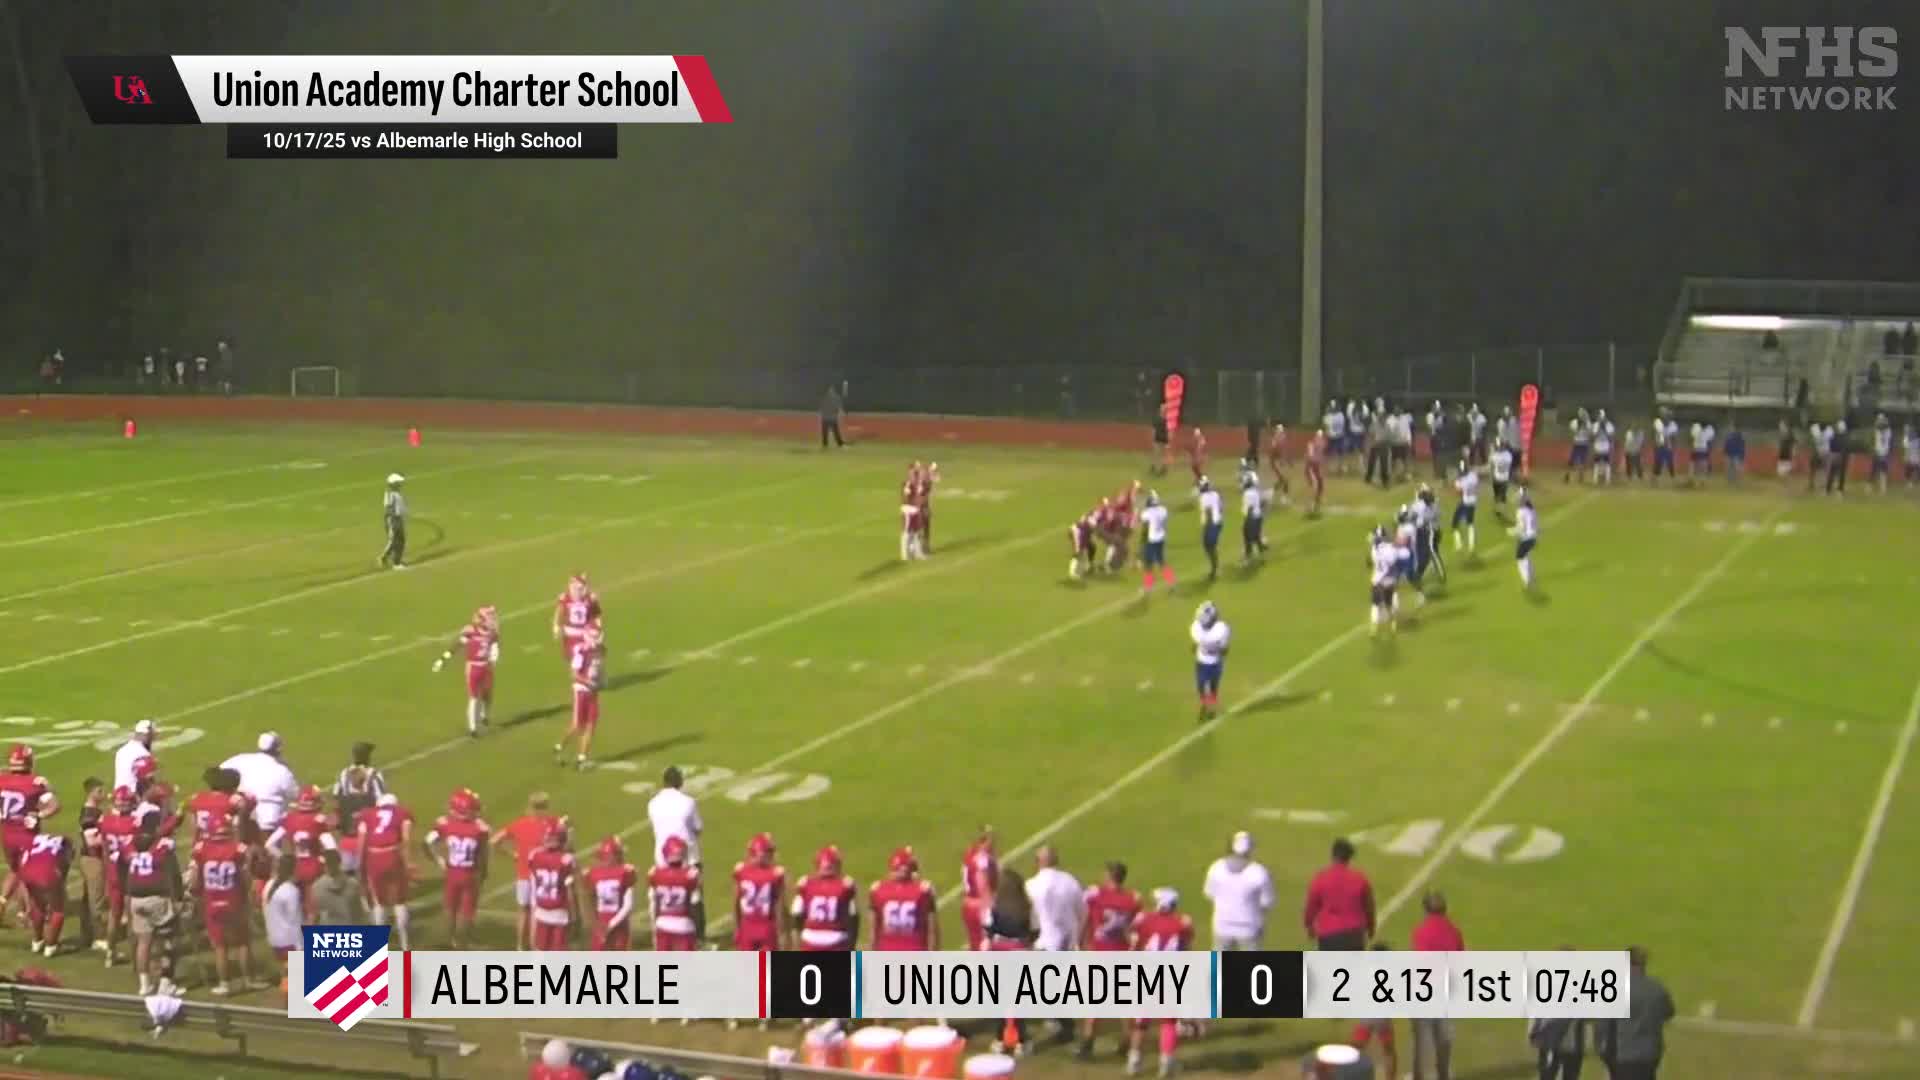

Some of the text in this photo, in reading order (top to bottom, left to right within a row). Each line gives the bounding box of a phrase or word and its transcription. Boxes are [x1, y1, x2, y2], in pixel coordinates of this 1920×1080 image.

[374, 809, 393, 834] 7
[1347, 817, 1566, 863] 40
[739, 879, 773, 916] 24
